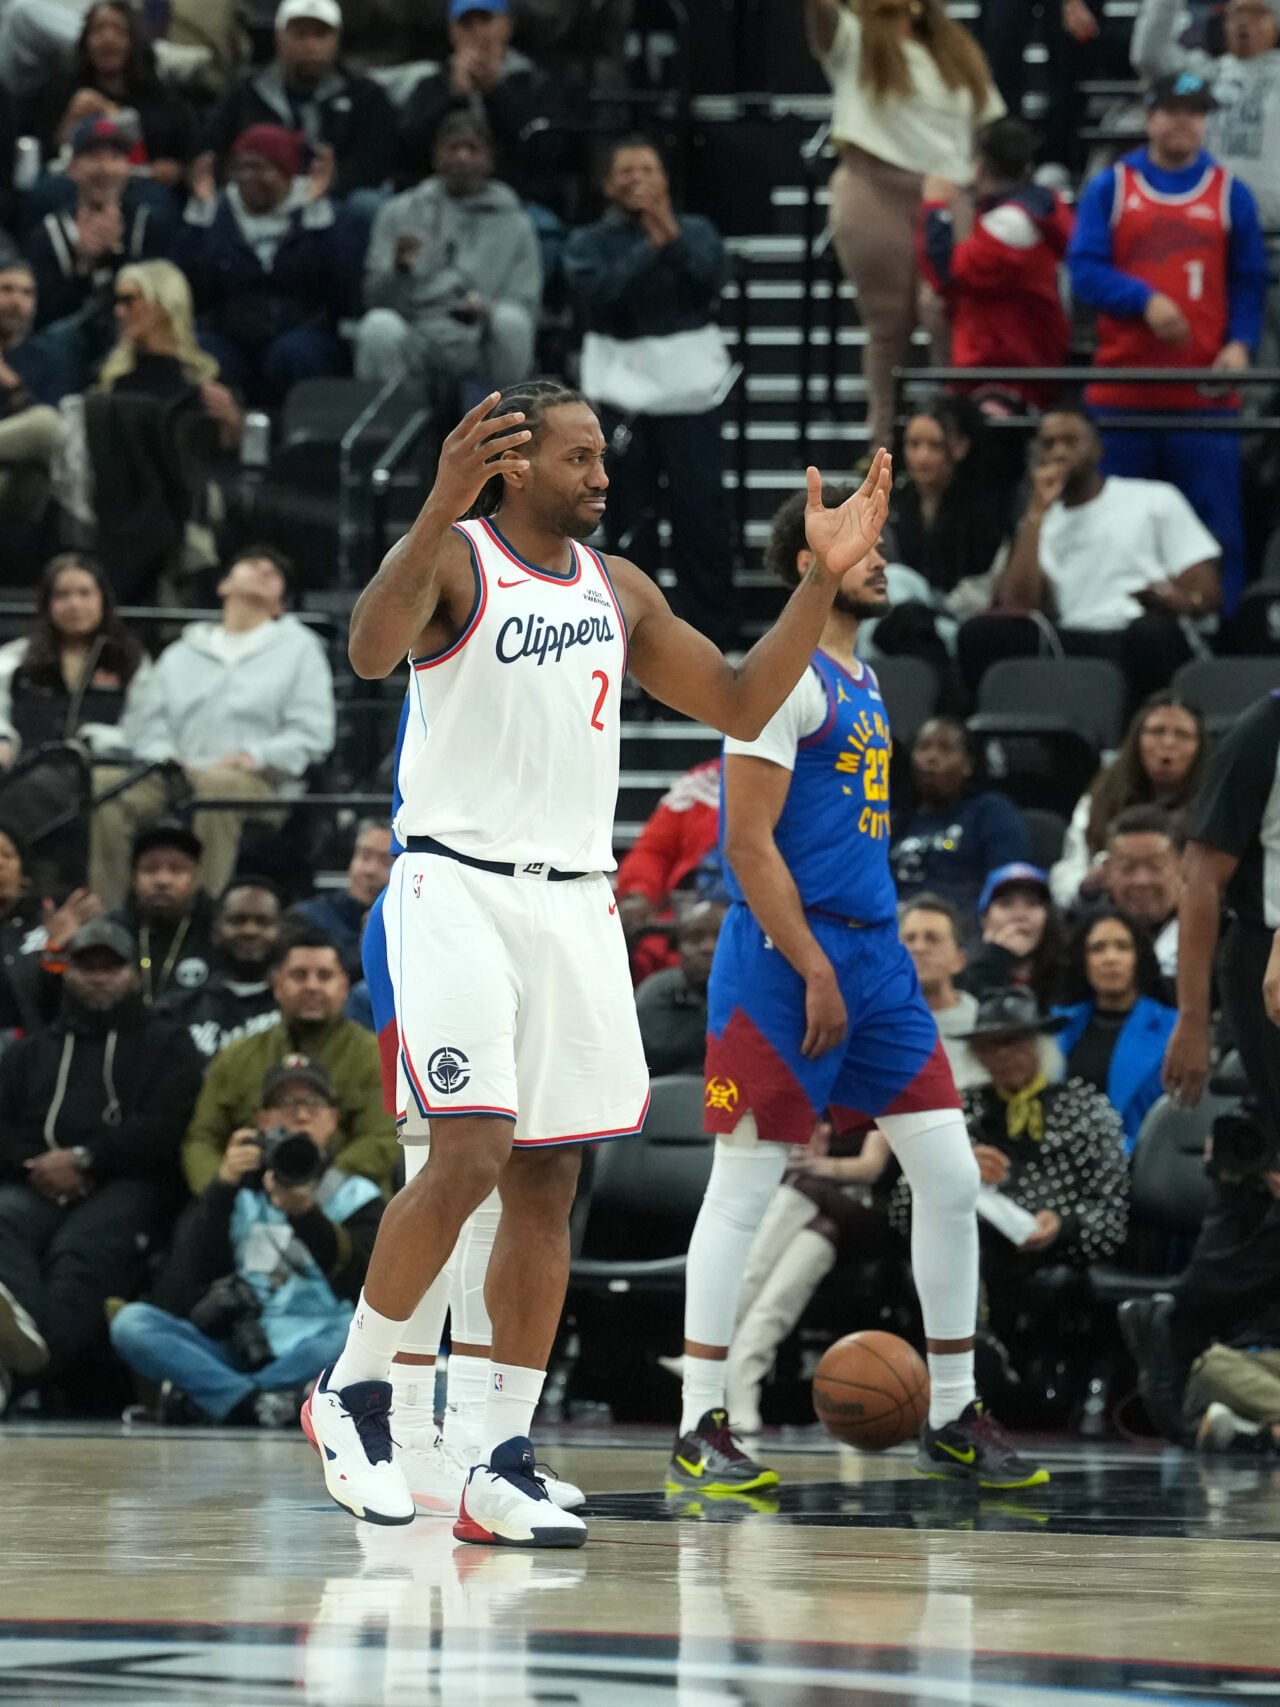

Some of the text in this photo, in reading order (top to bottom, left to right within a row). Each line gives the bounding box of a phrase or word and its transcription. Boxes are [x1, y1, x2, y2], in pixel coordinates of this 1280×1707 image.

[1183, 259, 1204, 301] 1
[495, 613, 615, 666] Clippers
[590, 669, 610, 731] 2
[834, 710, 874, 774] MILE
[863, 747, 889, 801] 23
